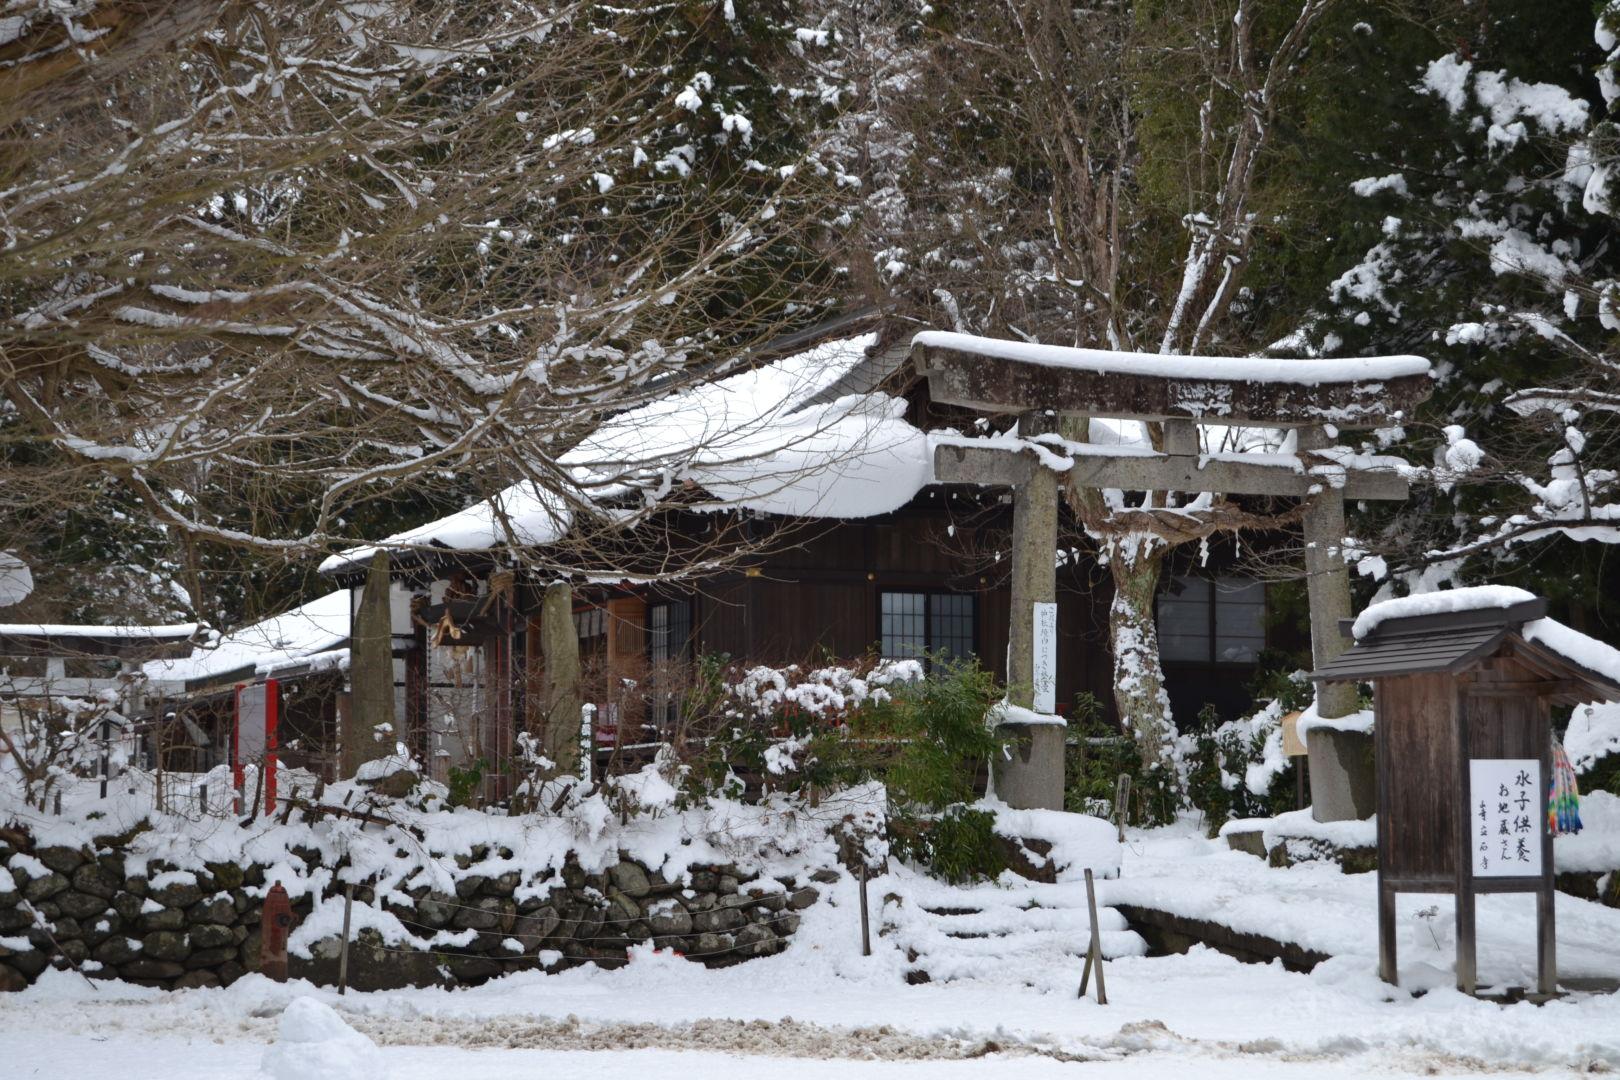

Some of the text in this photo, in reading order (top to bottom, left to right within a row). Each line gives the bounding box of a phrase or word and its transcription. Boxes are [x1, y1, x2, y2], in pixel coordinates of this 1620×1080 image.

[1498, 783, 1512, 860] お地蔵さん
[1514, 770, 1532, 863] 水子供養
